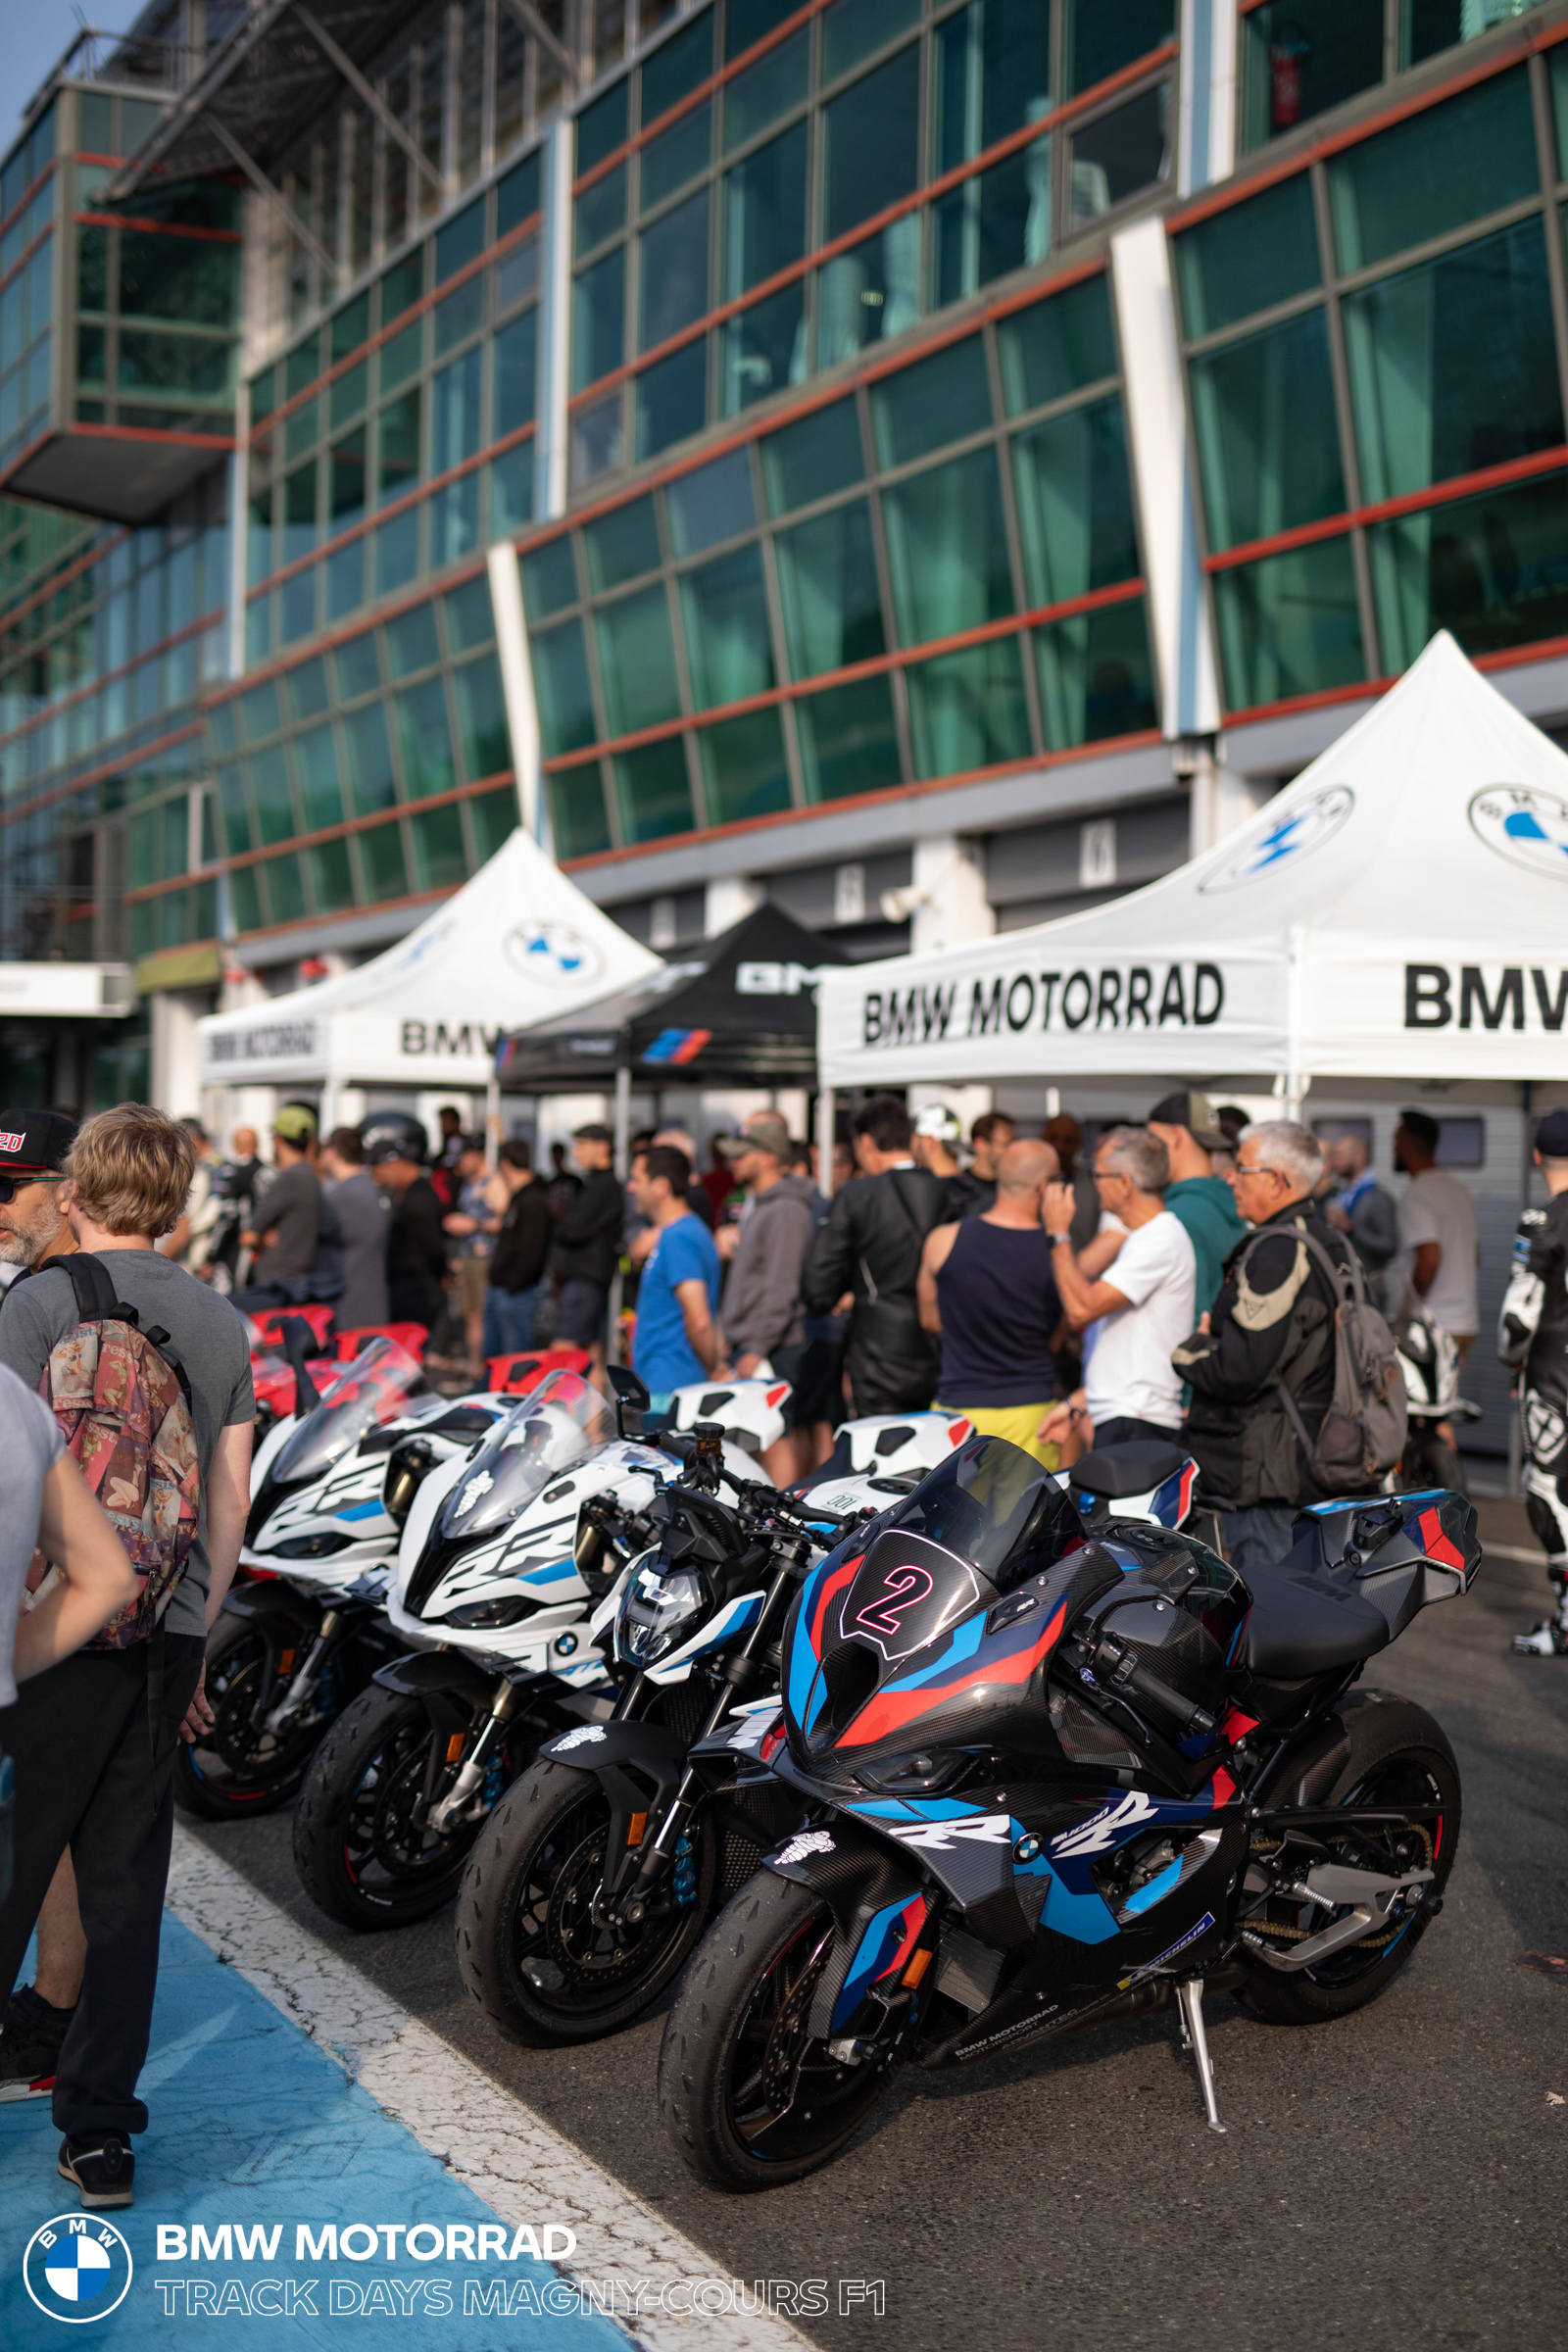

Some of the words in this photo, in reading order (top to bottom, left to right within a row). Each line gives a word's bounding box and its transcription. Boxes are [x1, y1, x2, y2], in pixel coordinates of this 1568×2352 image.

[864, 983, 956, 1045] BMW
[968, 961, 1224, 1035] MOTORRAD
[856, 1564, 934, 1636] 2
[955, 2036, 987, 2057] BMW
[989, 2004, 1059, 2041] MOTORRAD
[959, 2021, 1039, 2061] MOTORSPORT
